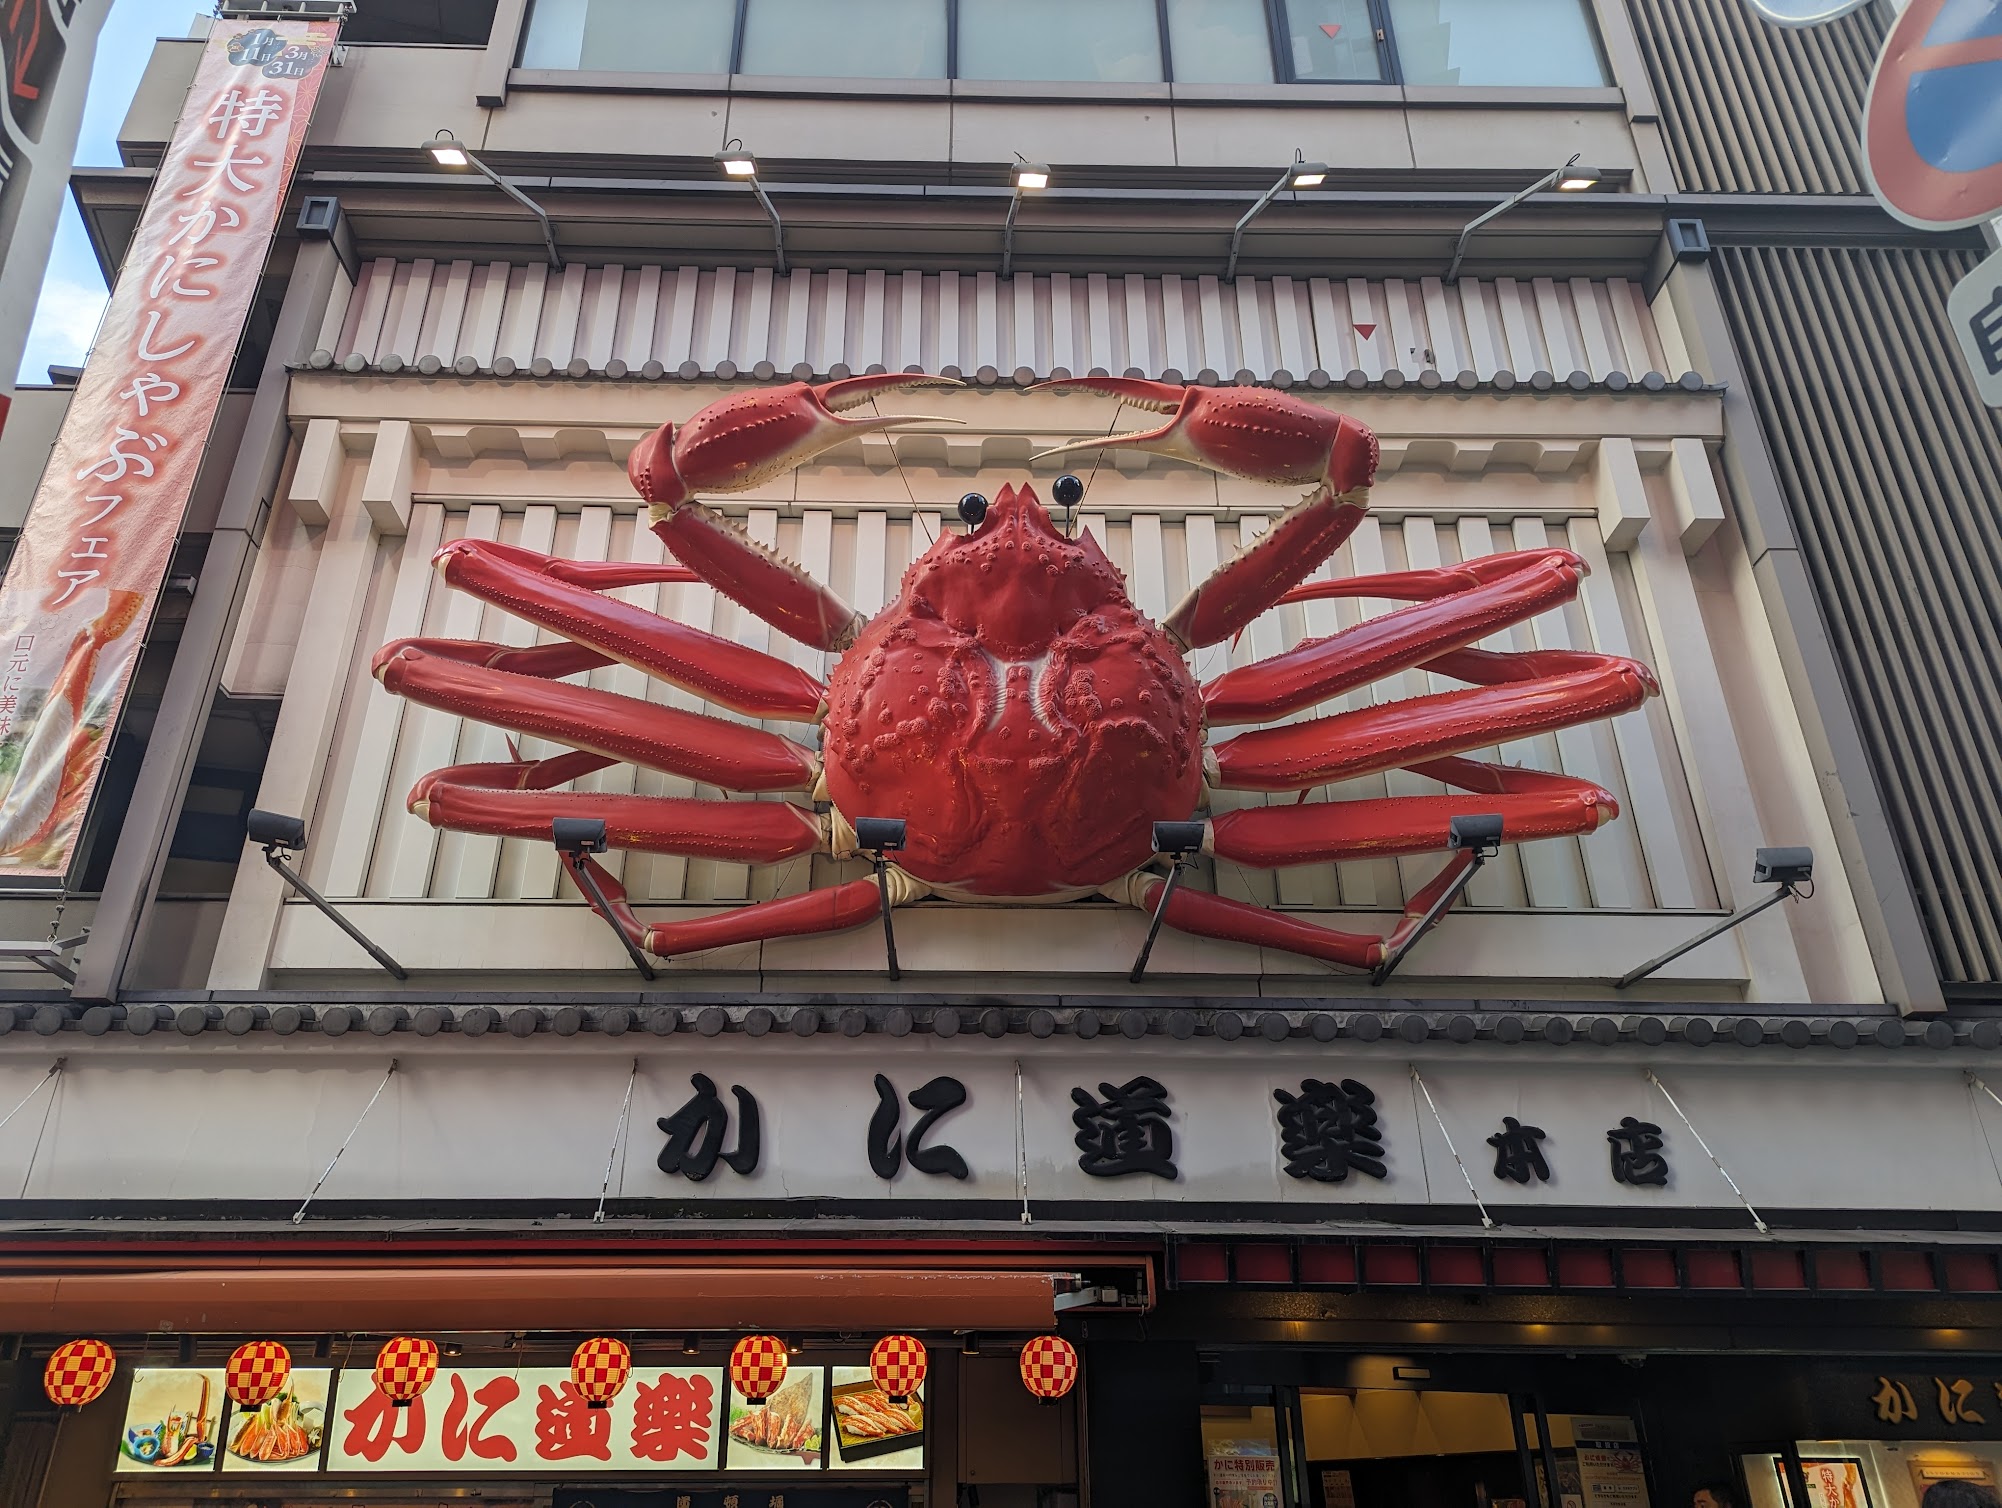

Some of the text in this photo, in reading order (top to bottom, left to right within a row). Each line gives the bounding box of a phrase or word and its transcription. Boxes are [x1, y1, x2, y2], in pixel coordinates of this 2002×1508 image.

[250, 32, 275, 46] 1月
[239, 47, 272, 61] 11日
[285, 45, 309, 60] 3月
[268, 61, 304, 76] 31日
[1486, 1116, 1669, 1186] 本店
[1872, 1376, 2002, 1424] かに
[1214, 1459, 1275, 1471] かに特別販売
